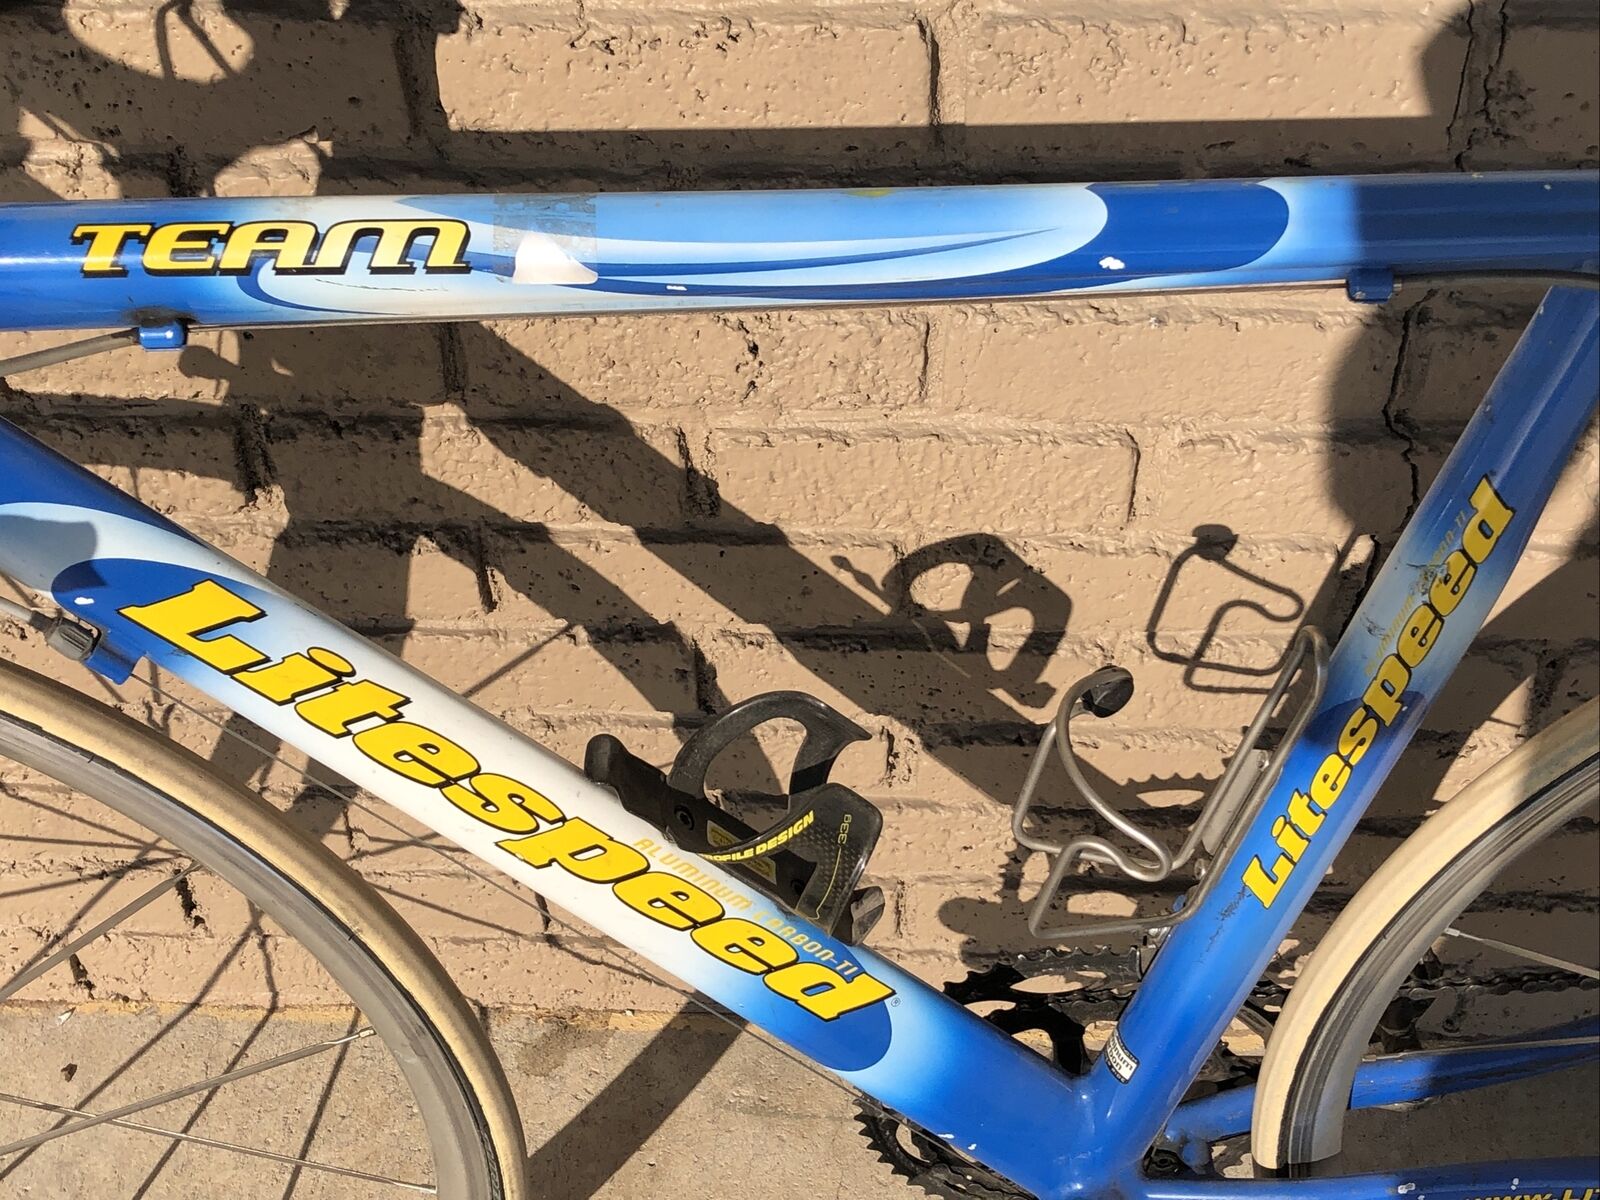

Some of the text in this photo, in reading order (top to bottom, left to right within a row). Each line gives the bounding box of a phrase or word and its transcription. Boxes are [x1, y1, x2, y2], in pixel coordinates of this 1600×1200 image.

[70, 218, 472, 278] TEAM
[1241, 473, 1516, 909] Litespeed
[117, 578, 898, 1021] Litespeed
[756, 810, 815, 856] DESIGN
[837, 814, 852, 844] 33g
[633, 837, 752, 911] ALUMINUM
